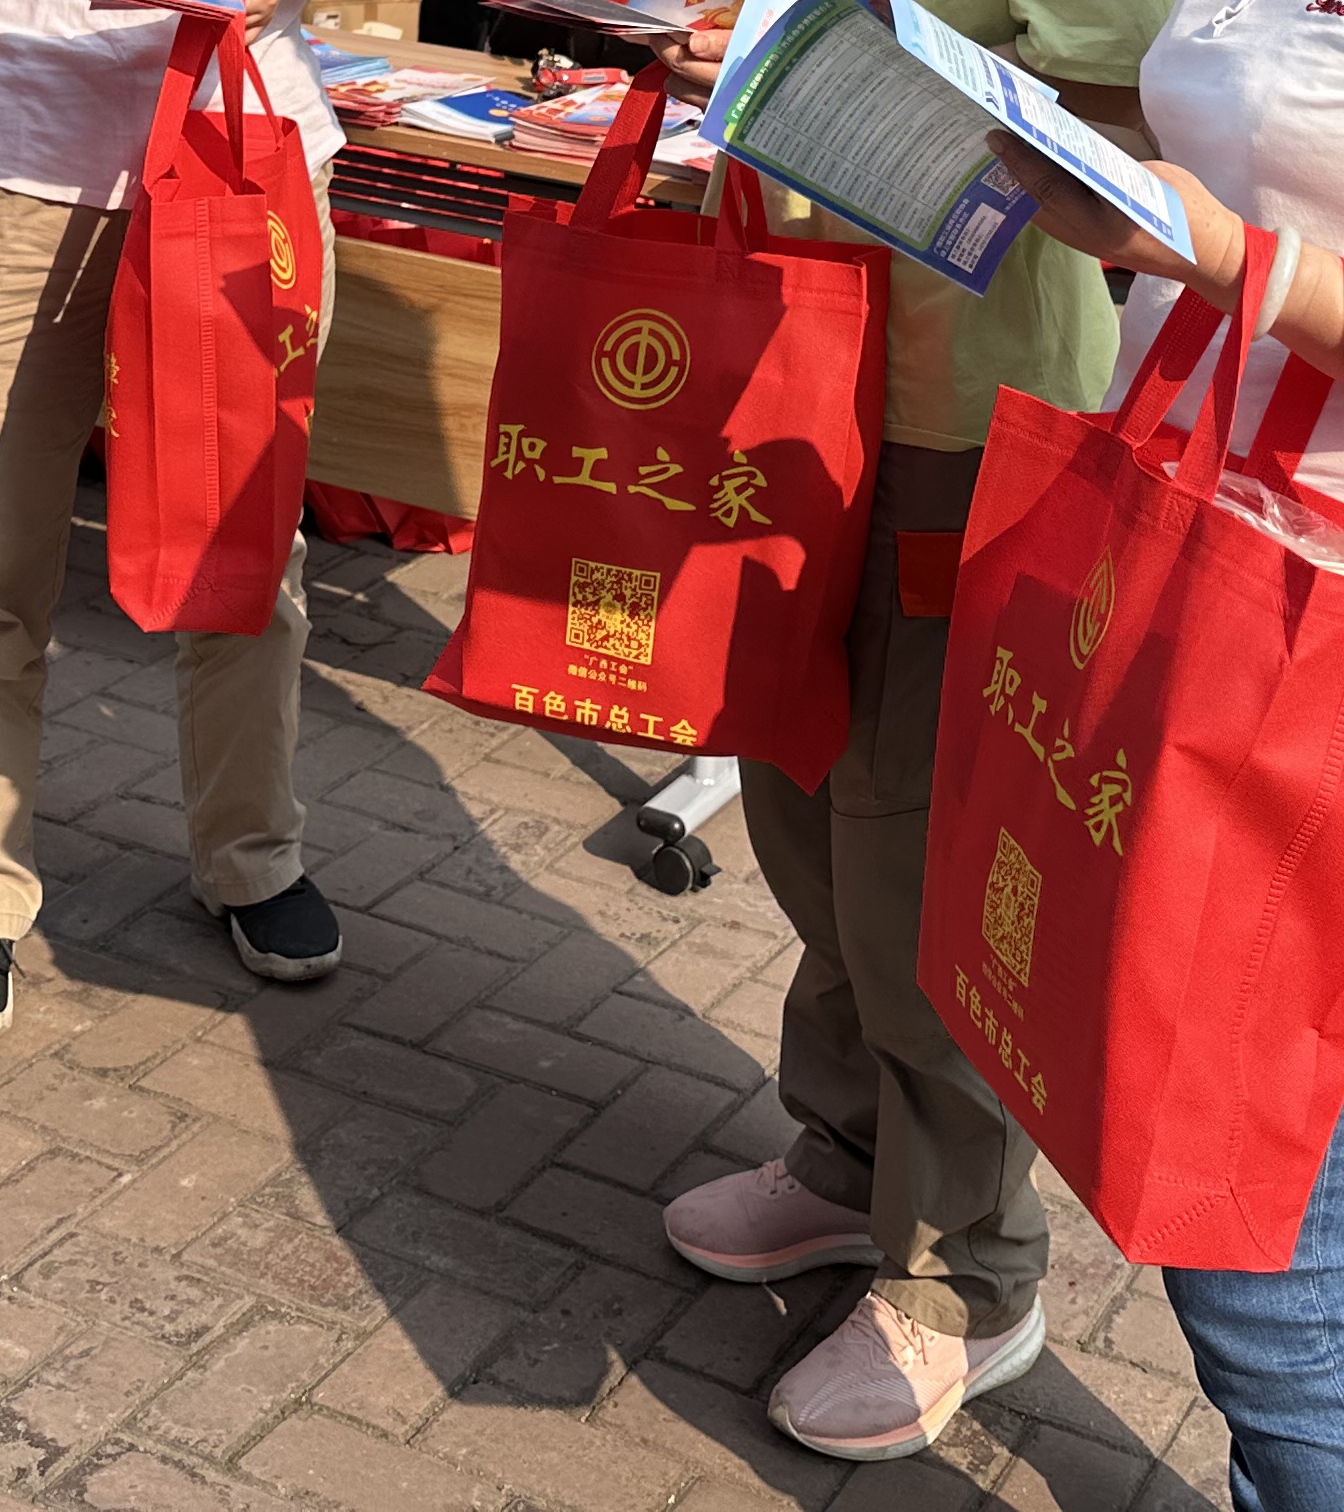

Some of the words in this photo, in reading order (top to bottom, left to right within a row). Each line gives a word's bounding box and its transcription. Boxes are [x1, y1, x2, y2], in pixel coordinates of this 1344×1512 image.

[490, 423, 773, 529] 职工之家
[511, 684, 702, 747] 百色市总工会
[981, 645, 1137, 857] 职工之家
[953, 963, 1048, 1117] 百色市总工会
